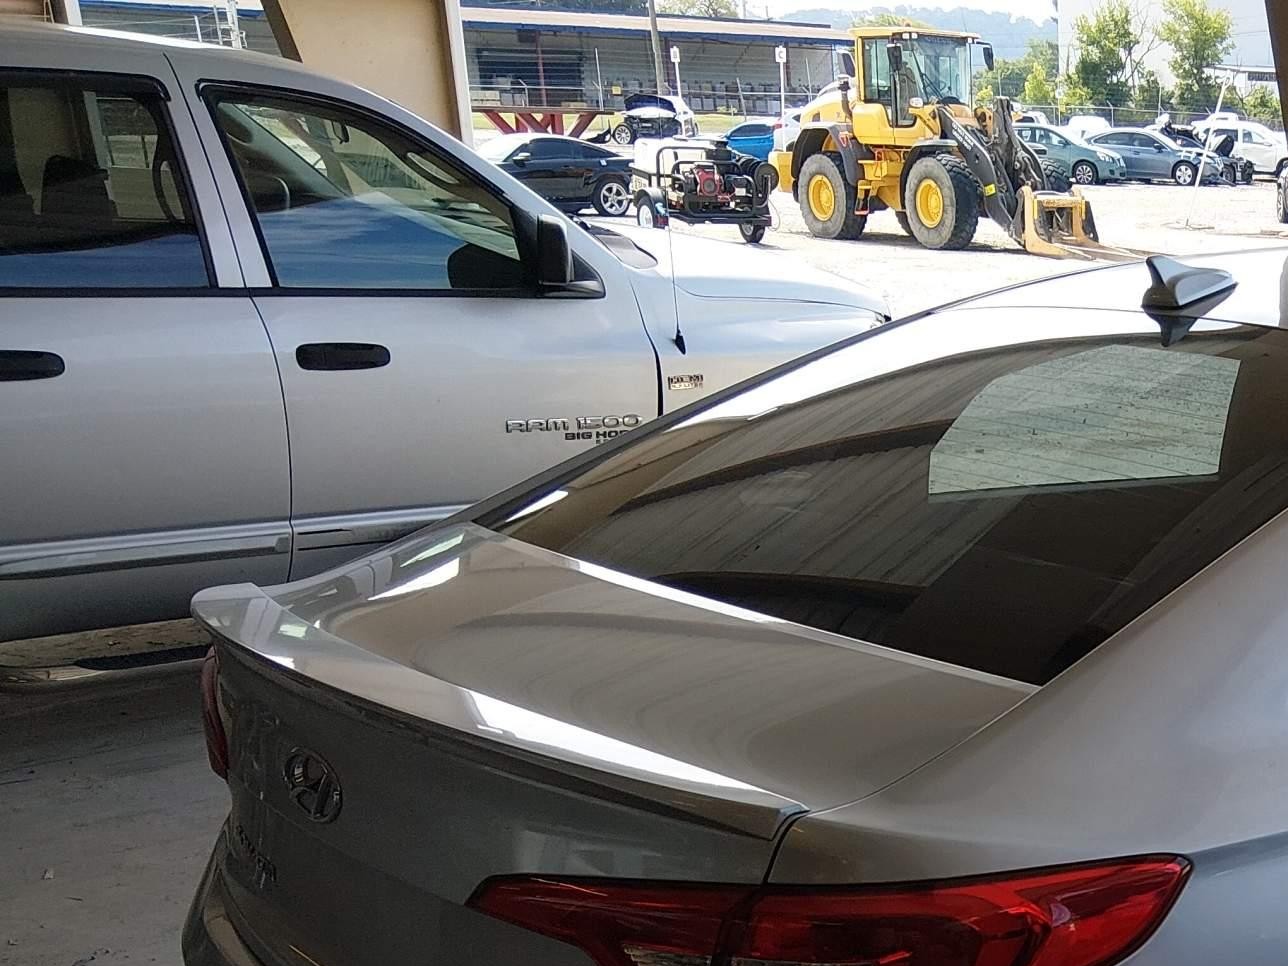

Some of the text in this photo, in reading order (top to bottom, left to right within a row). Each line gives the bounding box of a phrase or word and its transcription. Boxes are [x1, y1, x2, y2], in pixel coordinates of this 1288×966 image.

[505, 414, 643, 434] RAM 1500
[565, 431, 593, 441] BIG
